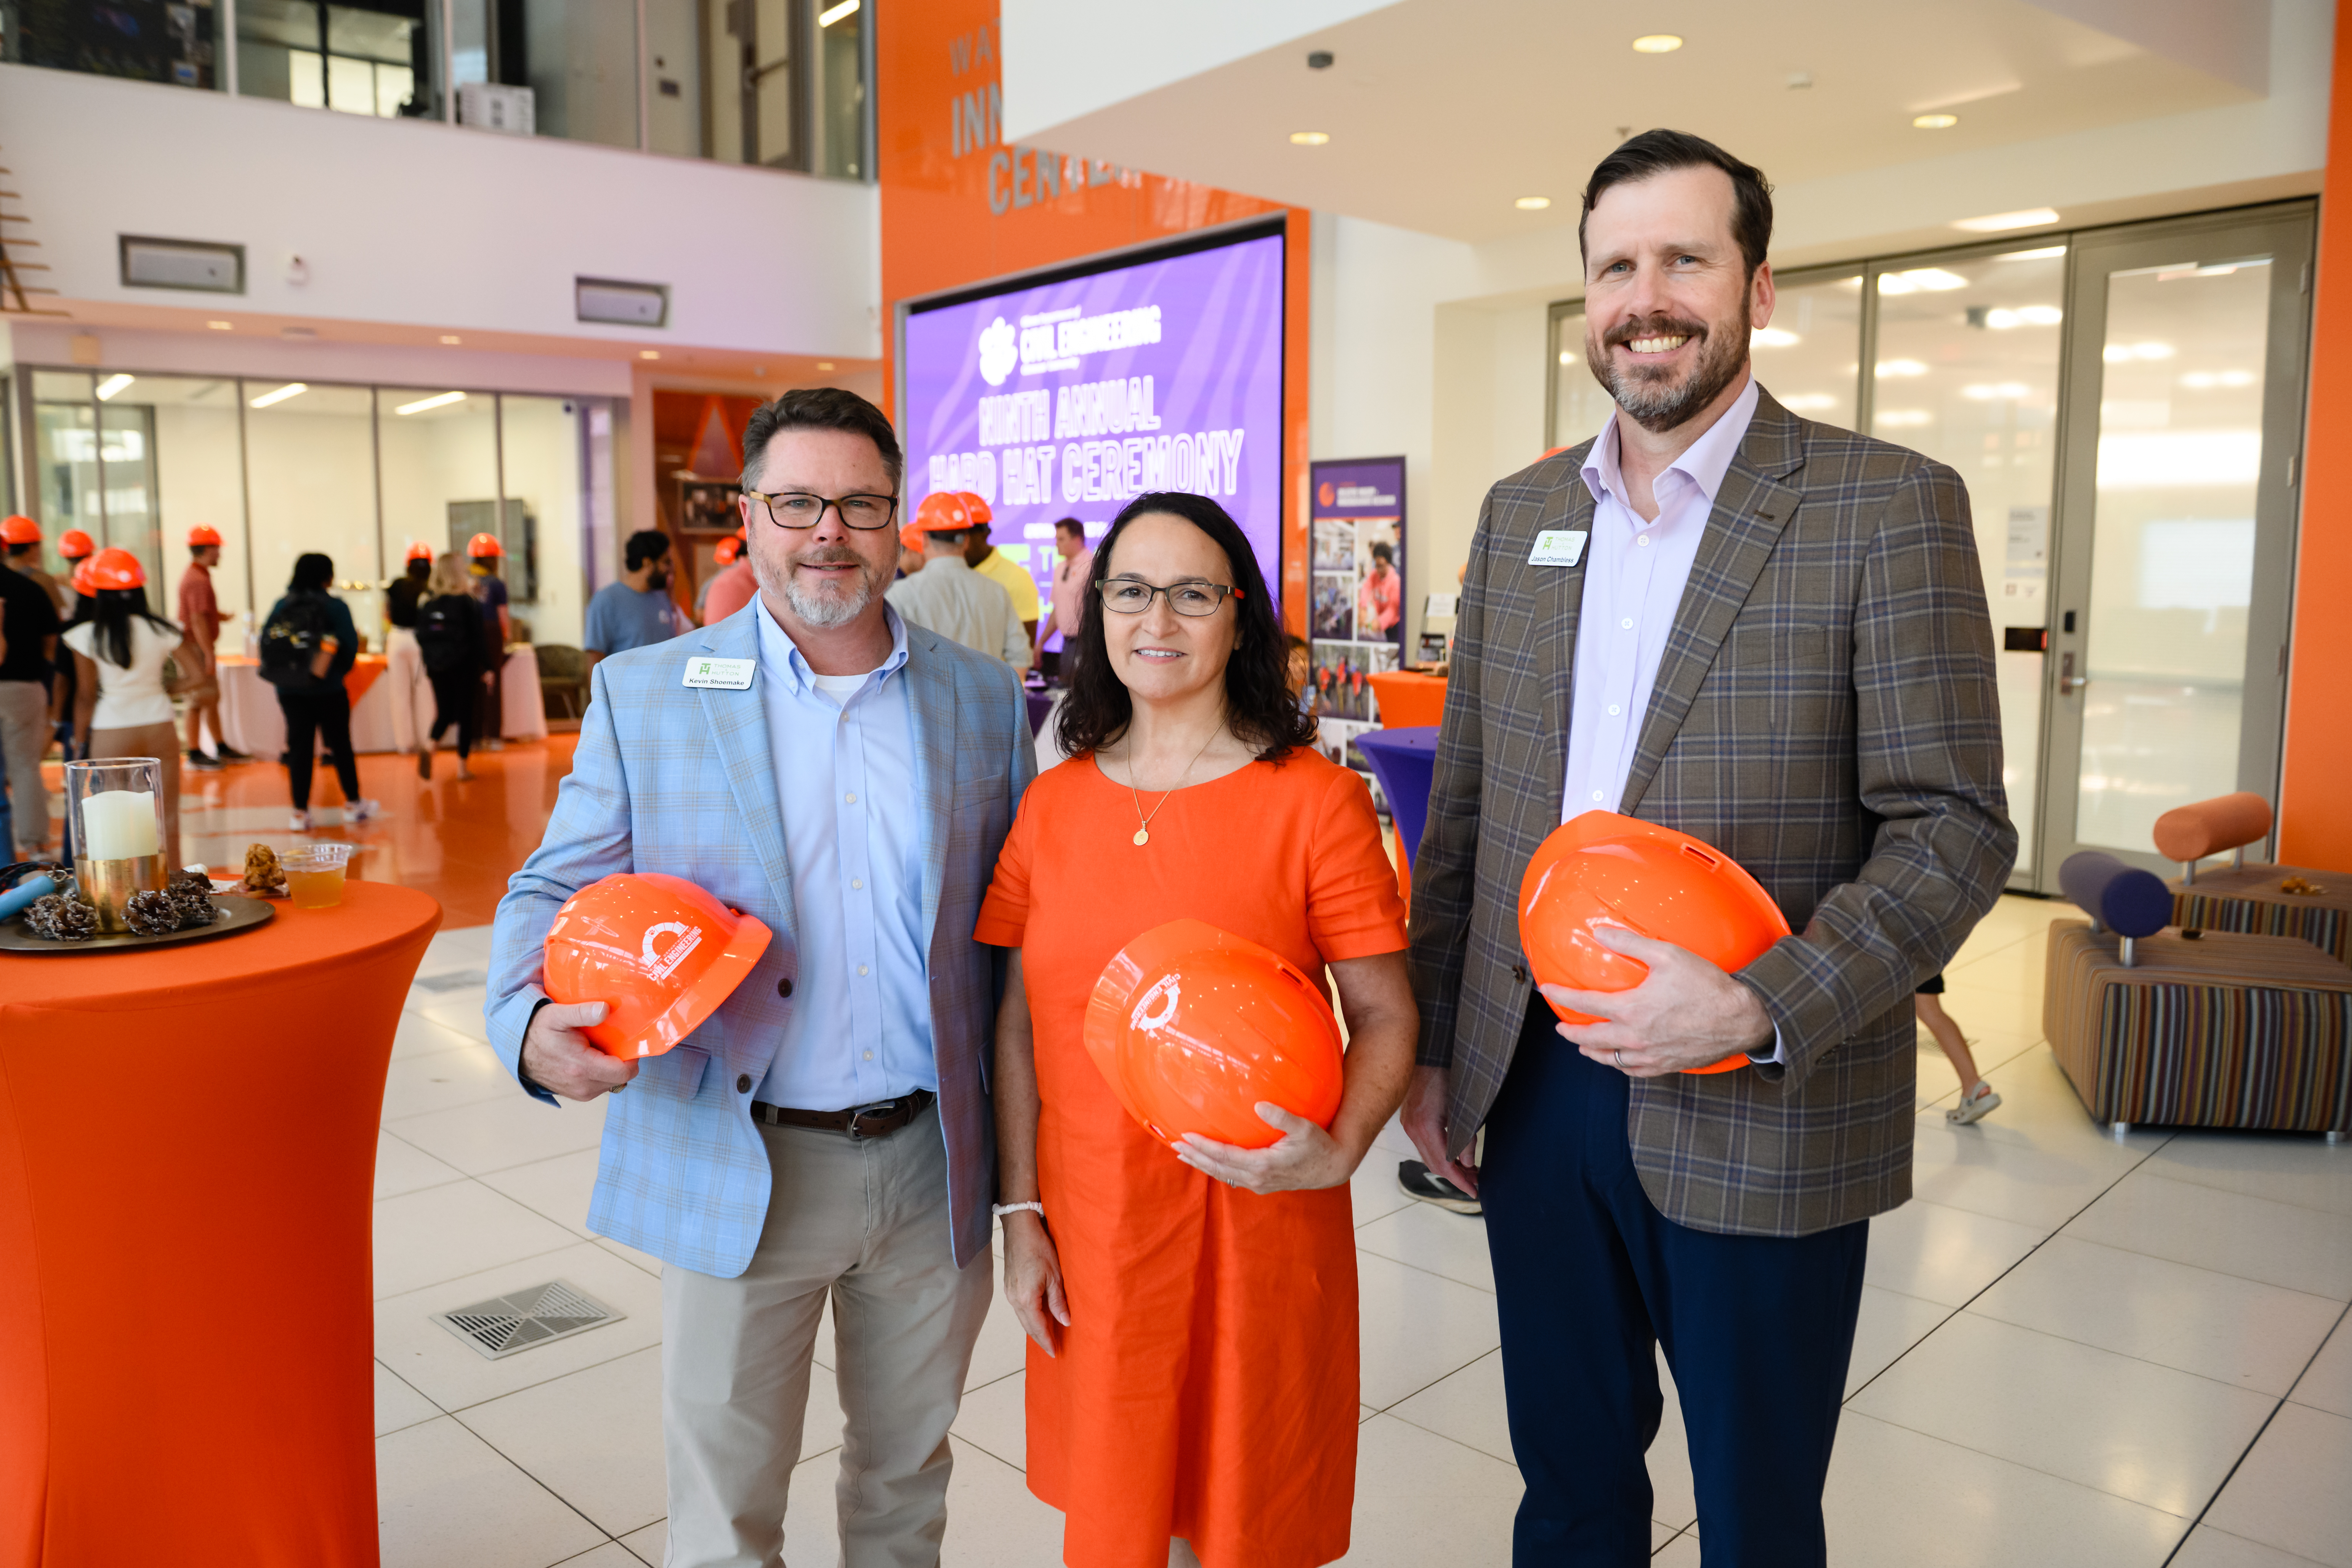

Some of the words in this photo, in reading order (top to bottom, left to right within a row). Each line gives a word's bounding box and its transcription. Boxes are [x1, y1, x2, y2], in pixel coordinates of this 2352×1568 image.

[1058, 305, 1161, 358] ENGINEERING
[978, 389, 1050, 447] NINTH
[1054, 375, 1161, 439] ANNUAL
[929, 451, 996, 505] HARD
[1002, 445, 1056, 505] HAT
[1062, 428, 1244, 503] CEREMONY
[648, 963, 668, 981] CIVIL
[664, 926, 702, 966] ENGINEERING
[663, 932, 686, 957] DEPARTMENT
[1161, 973, 1181, 988] CIVIL
[1130, 986, 1163, 1031] ENGINEERING
